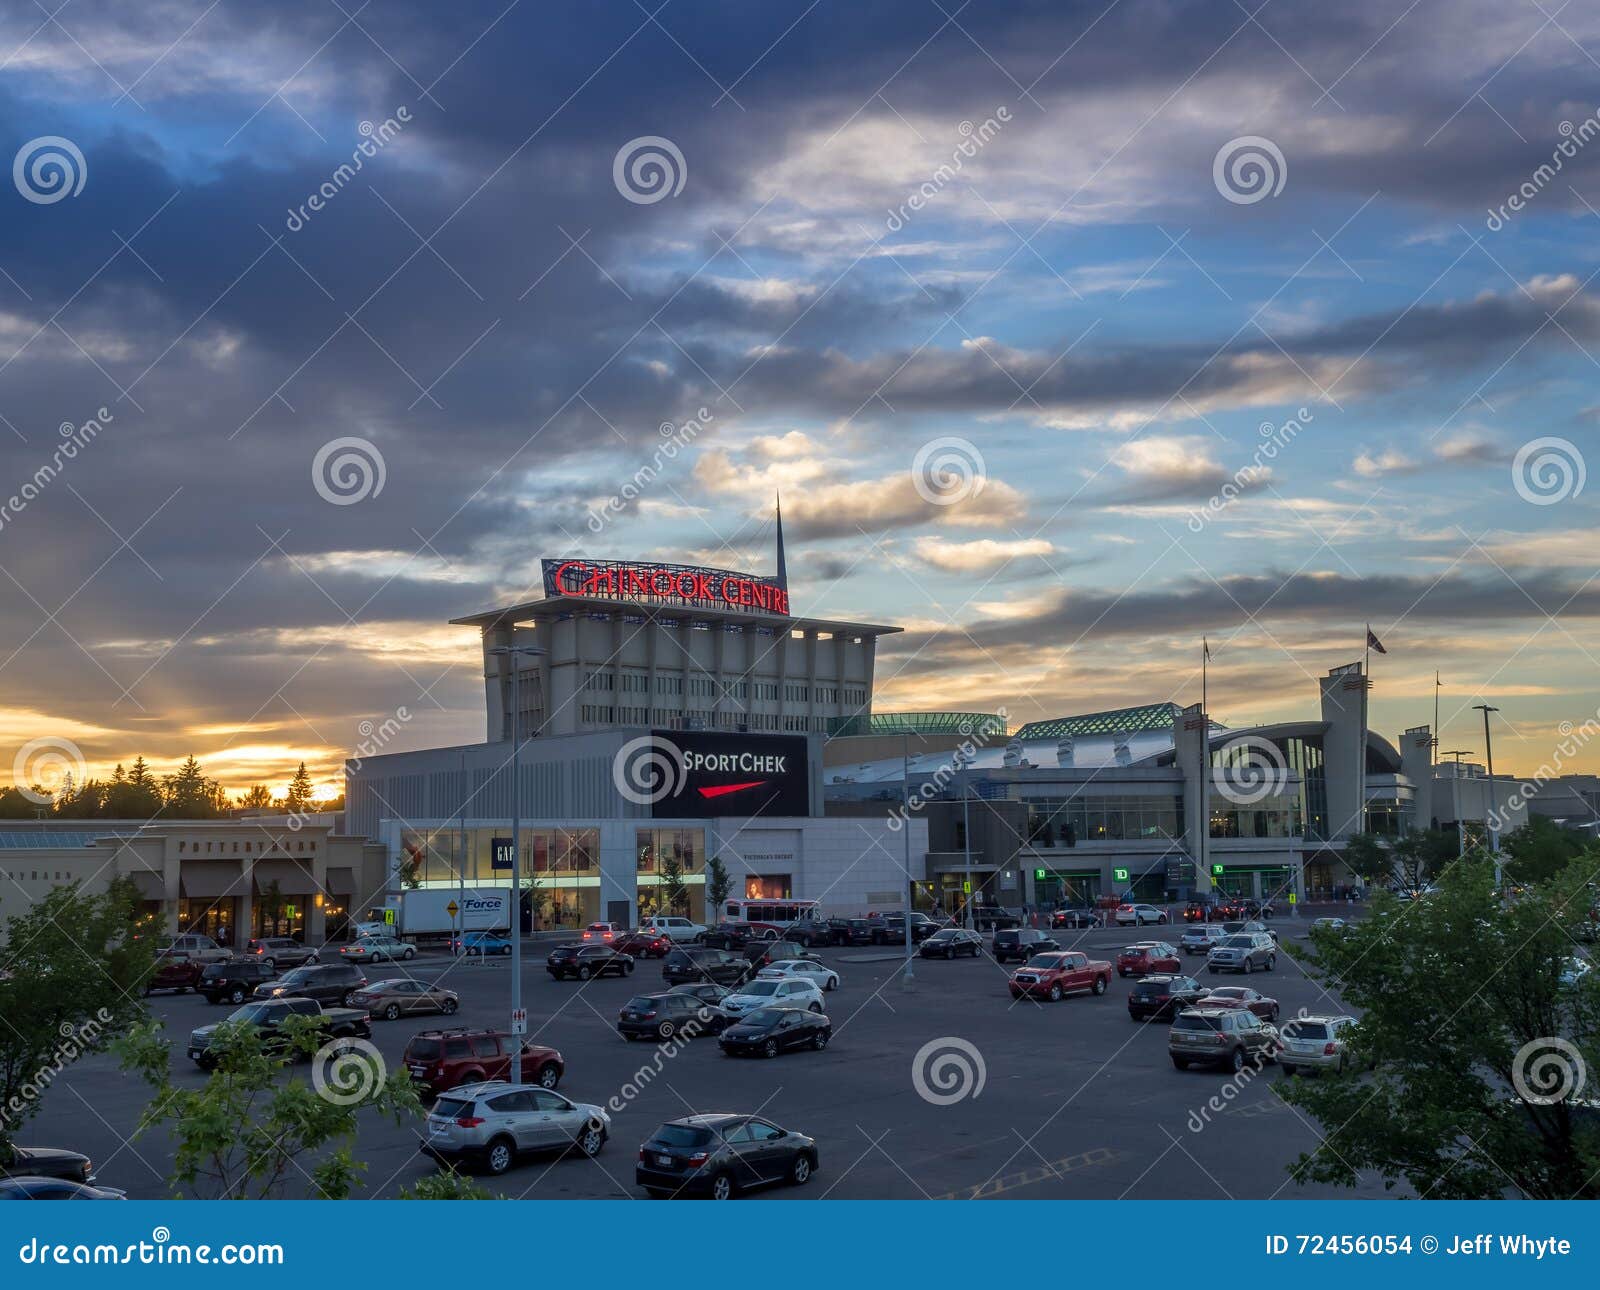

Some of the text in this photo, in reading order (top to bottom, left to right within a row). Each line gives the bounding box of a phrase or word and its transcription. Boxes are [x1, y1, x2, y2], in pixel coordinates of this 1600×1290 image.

[555, 561, 789, 614] CHINOOK CENTRE
[497, 846, 515, 861] GAP
[1114, 869, 1128, 880] TD
